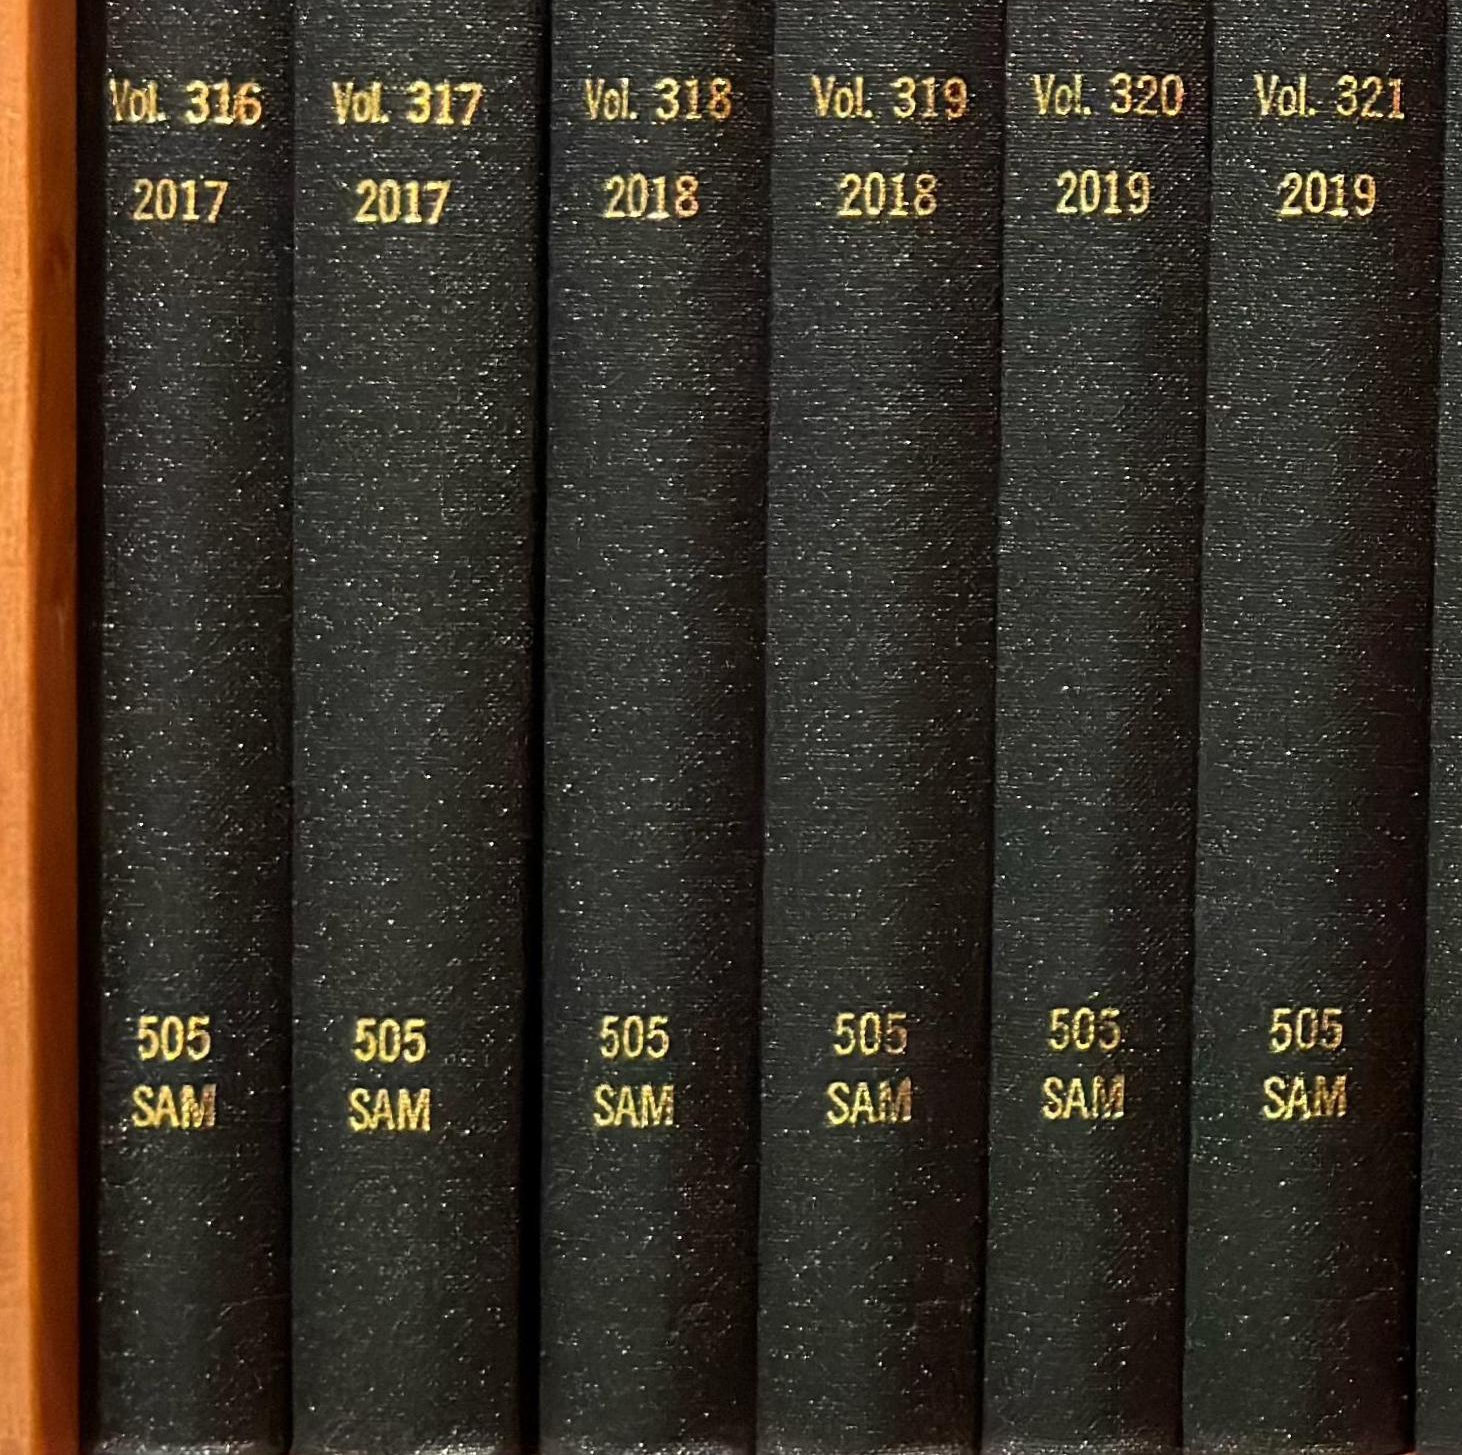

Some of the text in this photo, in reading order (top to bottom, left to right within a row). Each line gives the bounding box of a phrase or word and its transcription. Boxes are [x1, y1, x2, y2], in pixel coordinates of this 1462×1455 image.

[110, 80, 262, 125] Vol. 316
[585, 78, 732, 121] Vol. 318
[1254, 74, 1403, 119] Vol. 321
[132, 178, 229, 224] 2017
[606, 173, 700, 219] 2018
[1279, 172, 1377, 219] 2019
[137, 1015, 212, 1062] 505
[600, 1016, 670, 1061] 505
[1271, 1008, 1343, 1053] 505
[131, 1085, 216, 1130] SAM
[593, 1084, 675, 1129] SAM
[1263, 1074, 1347, 1121] SAM
